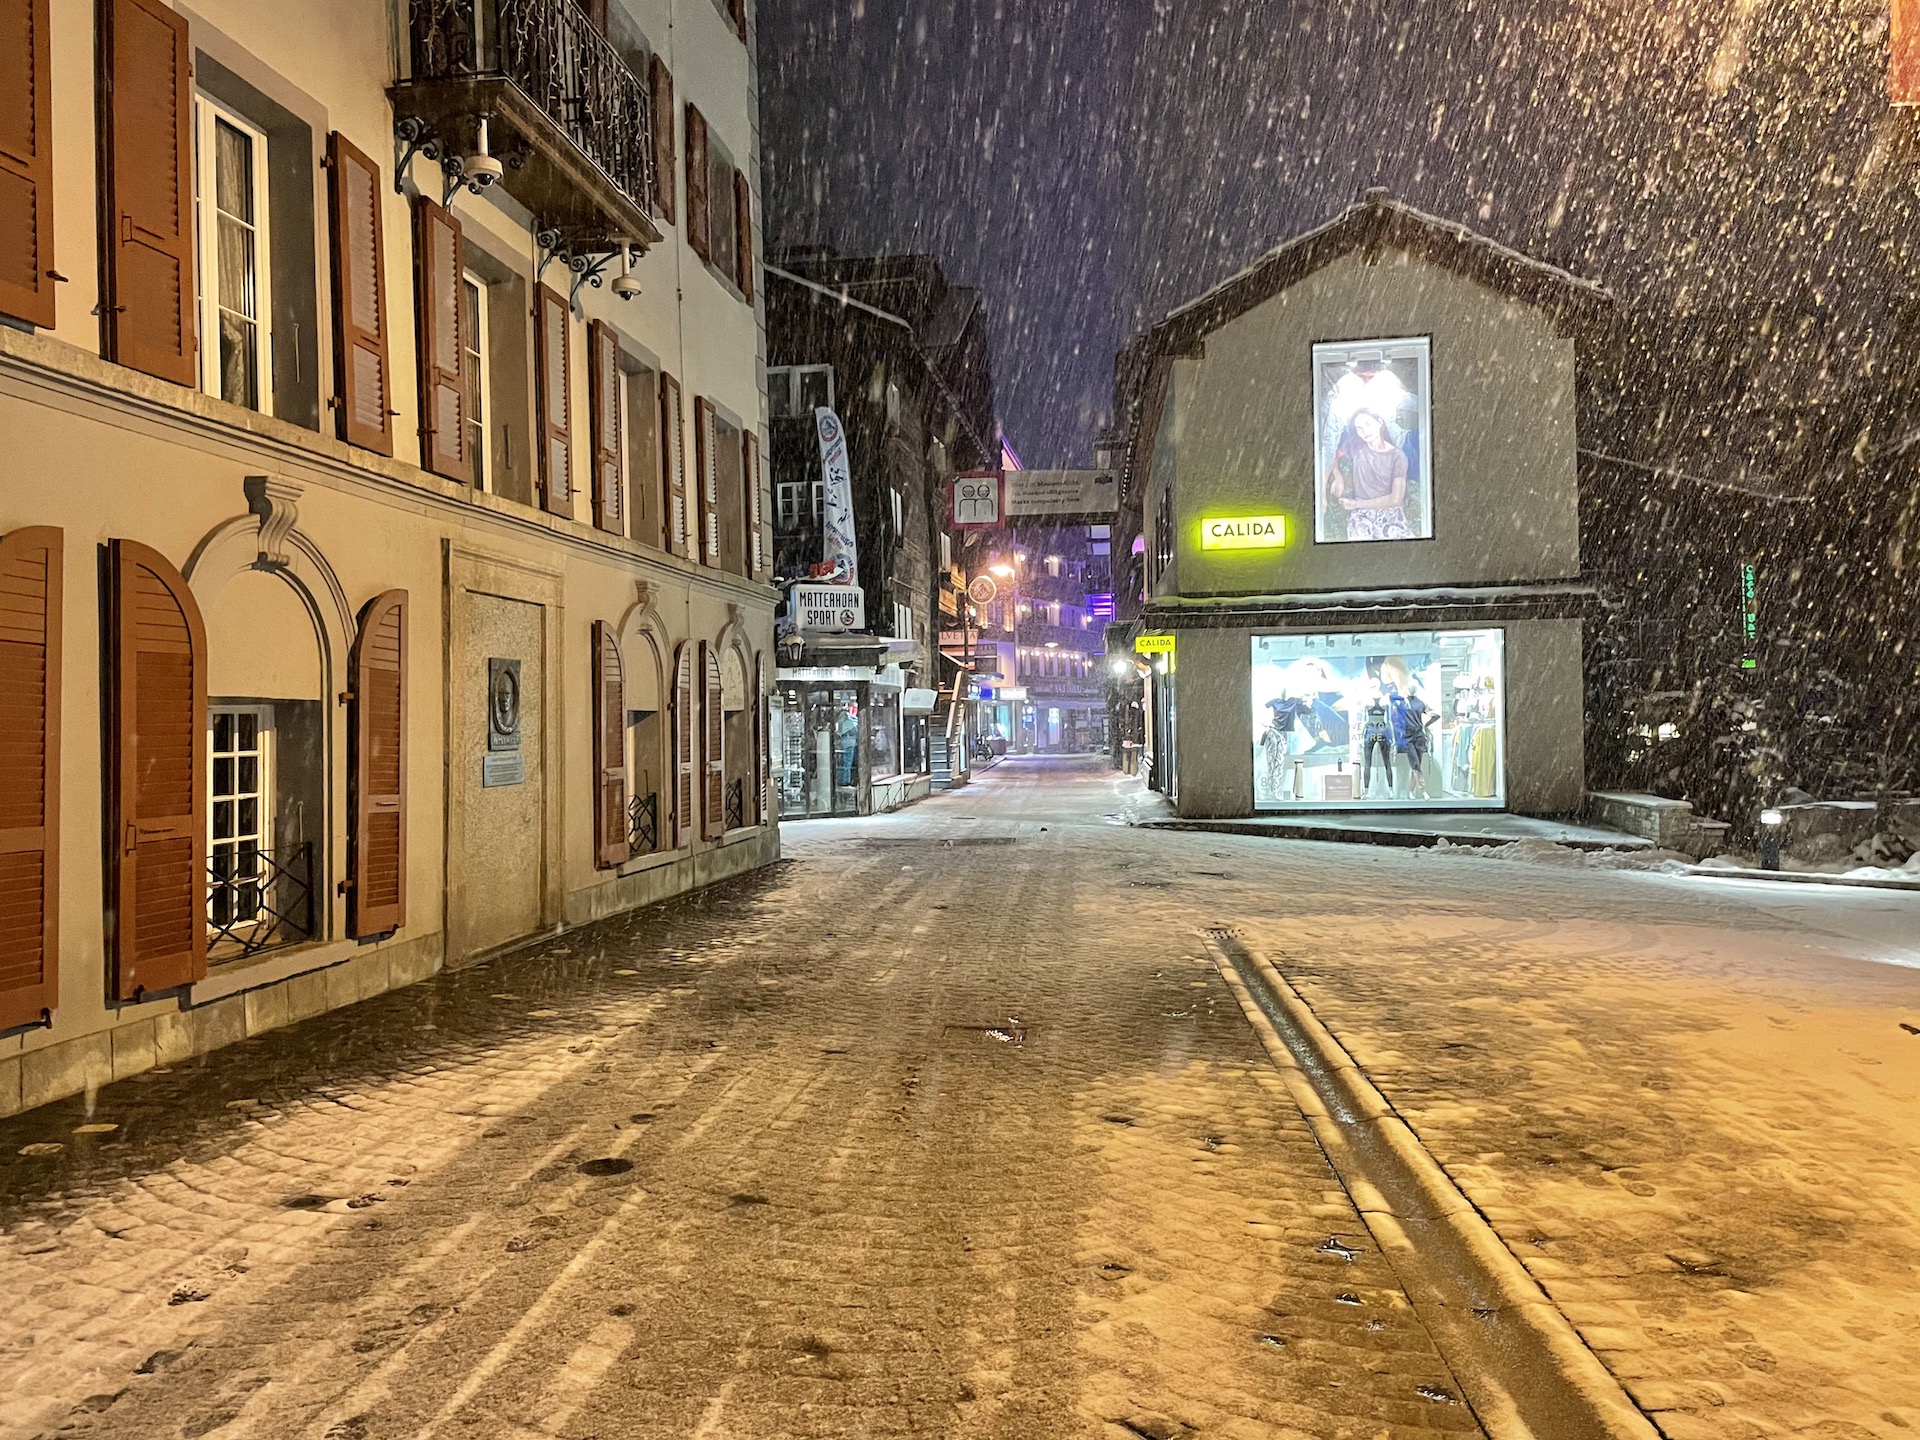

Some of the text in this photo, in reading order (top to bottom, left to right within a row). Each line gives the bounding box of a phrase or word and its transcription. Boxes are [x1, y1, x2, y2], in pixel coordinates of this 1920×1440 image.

[1211, 522, 1275, 537] CALIDA
[799, 592, 859, 608] MATTERHORN
[807, 609, 836, 625] SPORT
[1139, 639, 1172, 647] CALIDA
